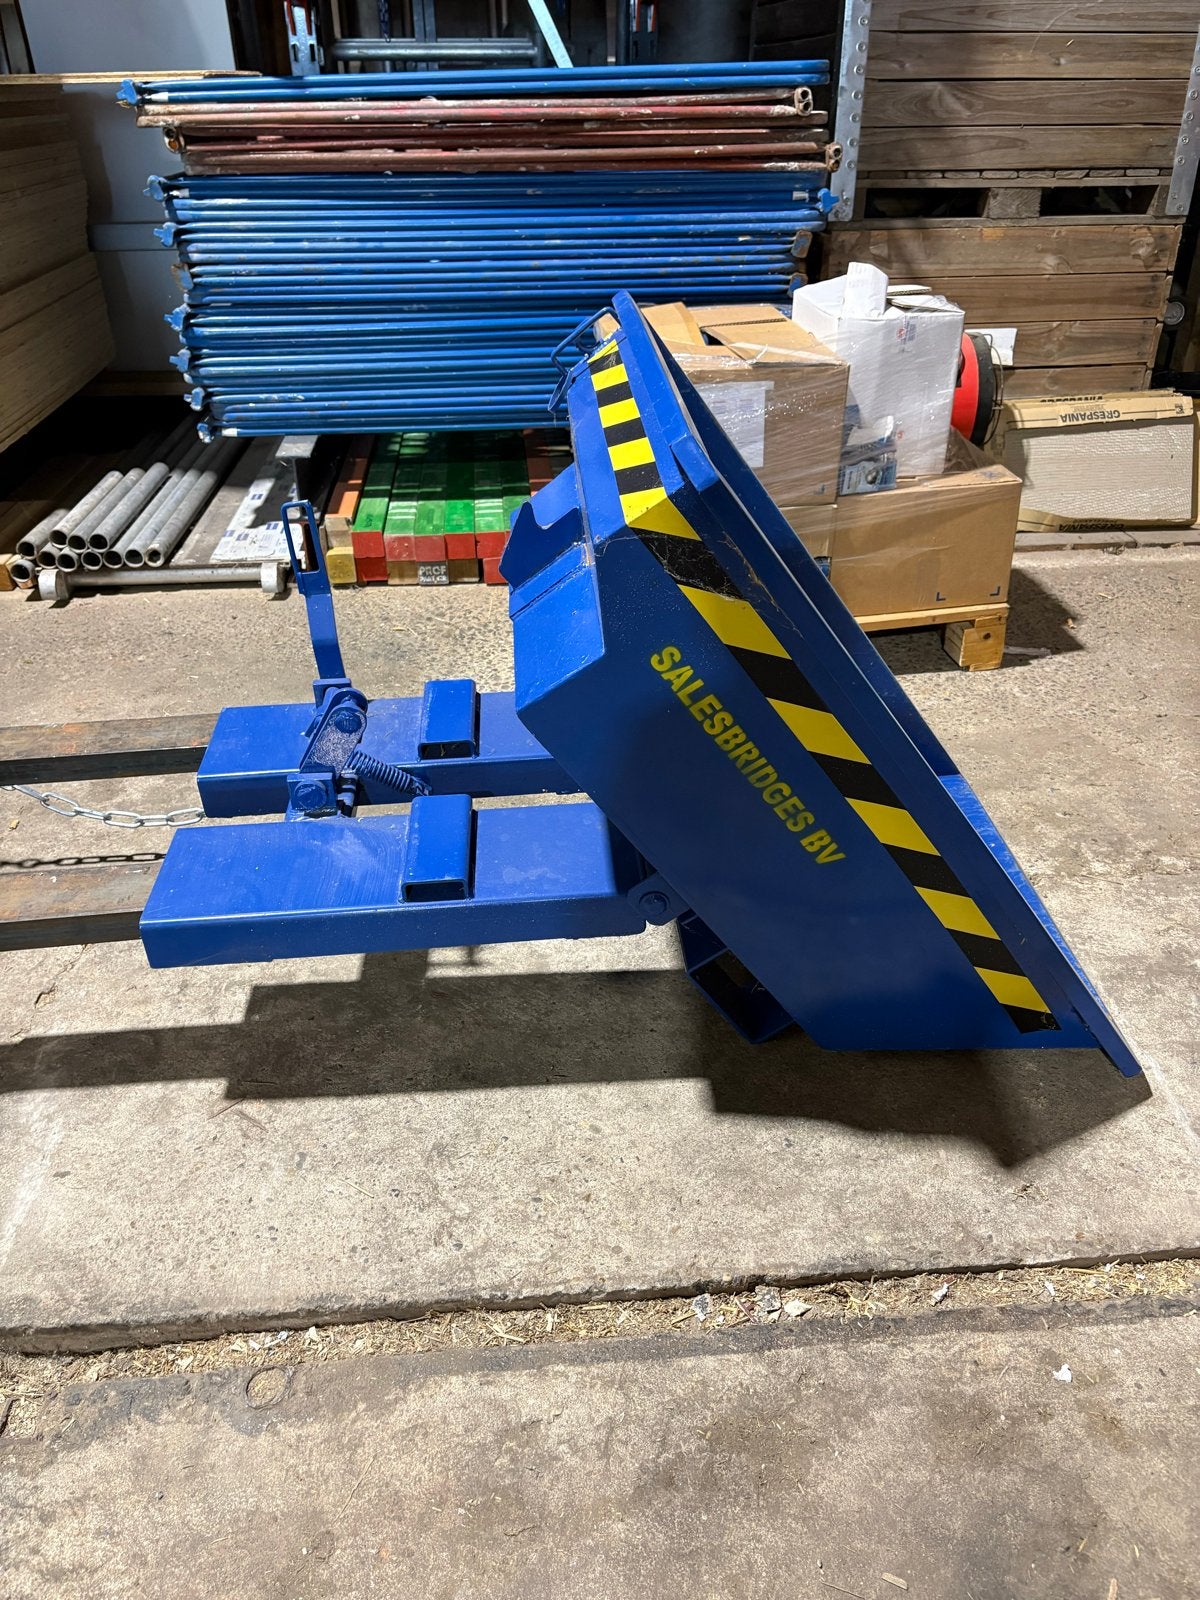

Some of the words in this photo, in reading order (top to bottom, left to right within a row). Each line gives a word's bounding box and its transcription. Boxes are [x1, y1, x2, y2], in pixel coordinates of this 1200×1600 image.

[1060, 409, 1121, 423] GRESPANIA
[650, 646, 815, 832] SALESBRIDGES
[800, 829, 846, 864] BV
